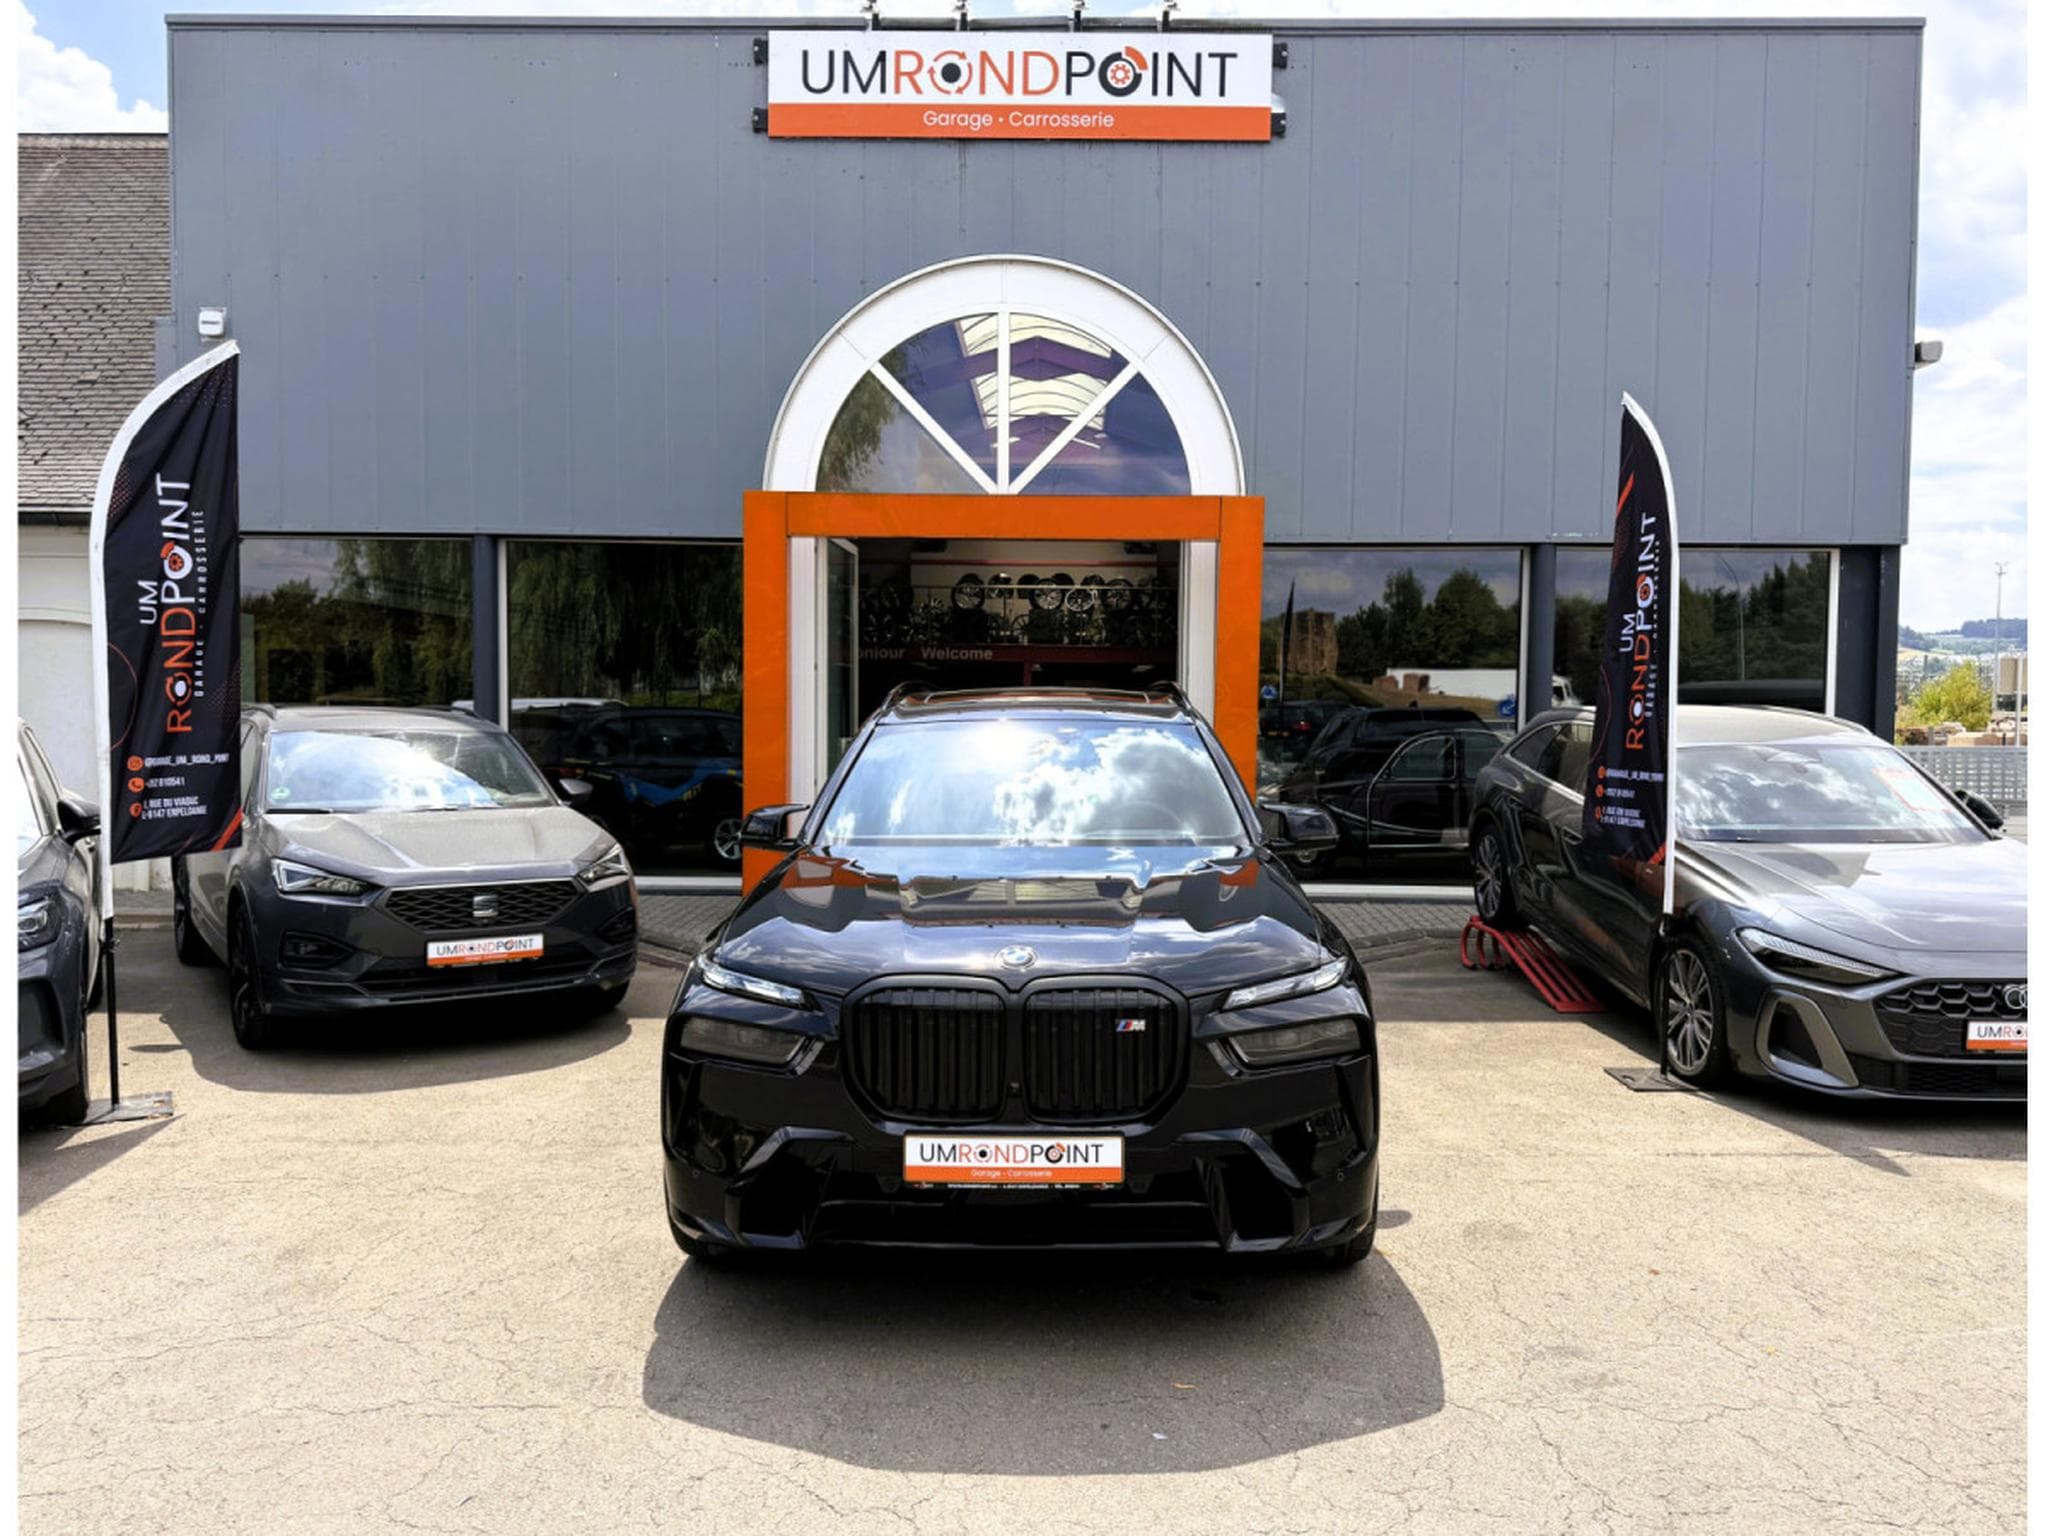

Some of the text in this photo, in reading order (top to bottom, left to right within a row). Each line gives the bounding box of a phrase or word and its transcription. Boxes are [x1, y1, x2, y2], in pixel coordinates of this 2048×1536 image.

[923, 110, 1115, 129] Garage Carrosserie
[138, 580, 158, 624] UM
[155, 473, 196, 733] RONDPOINT
[1619, 613, 1635, 652] UM
[1625, 512, 1656, 749] RONDPOINT
[921, 646, 993, 660] Welcome
[971, 1168, 1053, 1178] Garage Carrosserie
